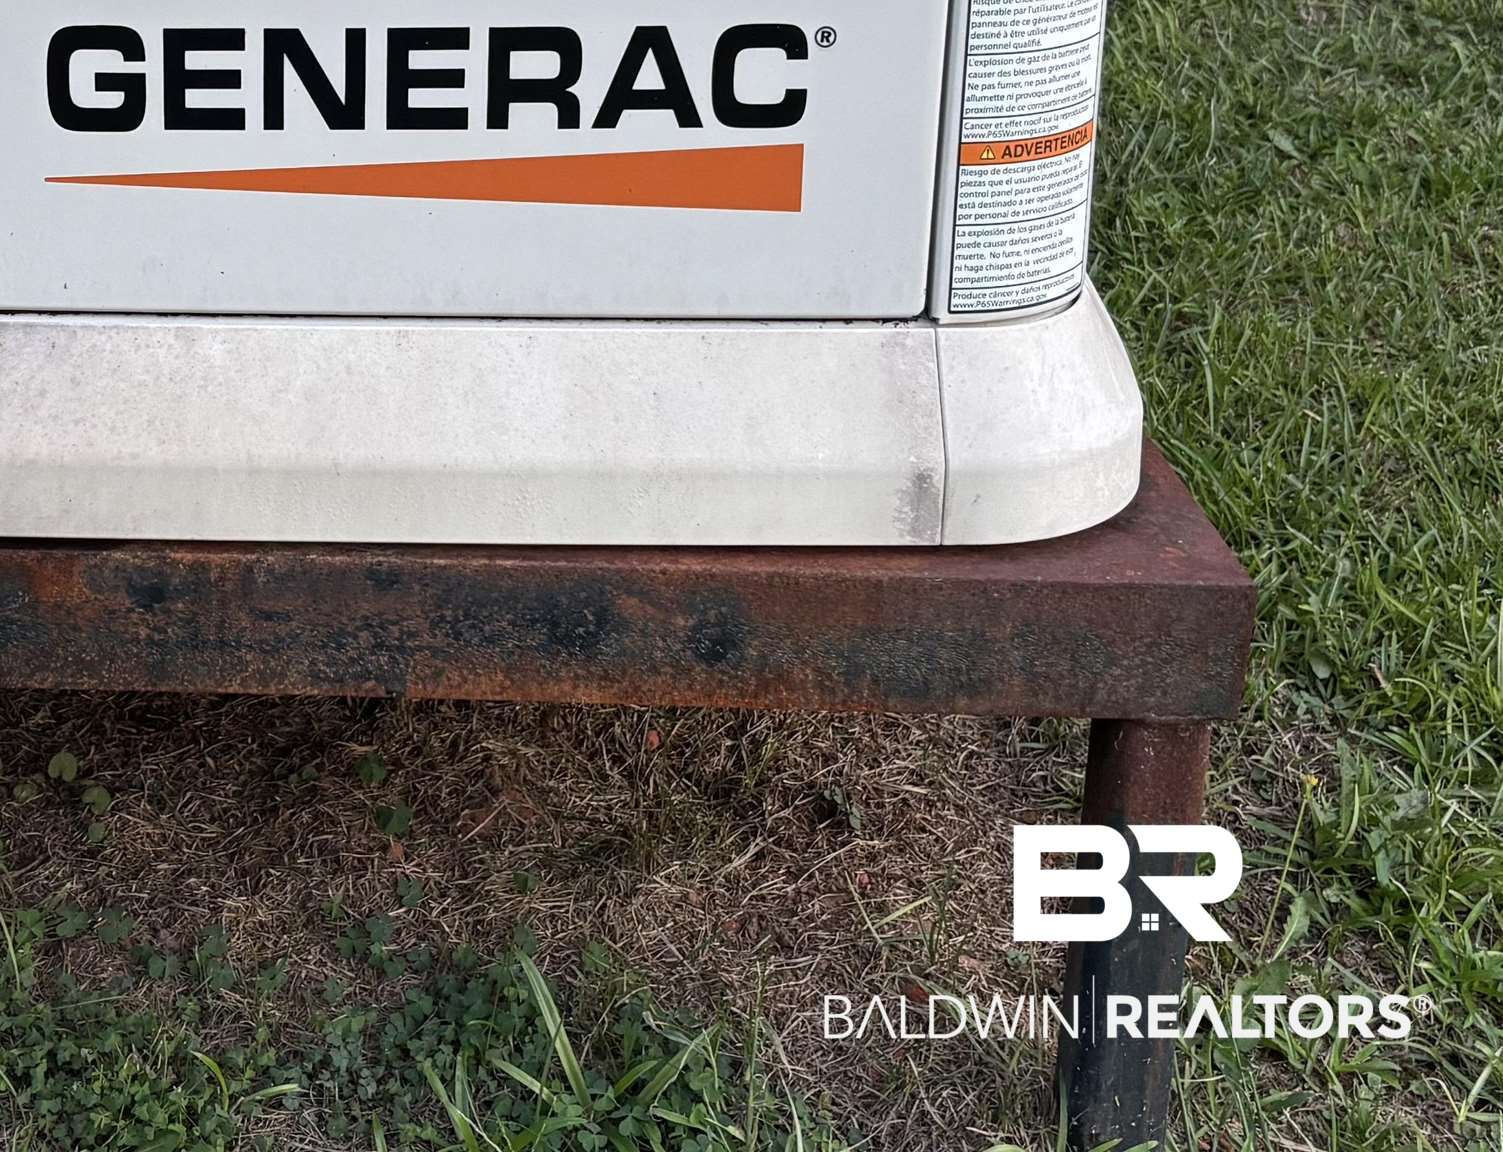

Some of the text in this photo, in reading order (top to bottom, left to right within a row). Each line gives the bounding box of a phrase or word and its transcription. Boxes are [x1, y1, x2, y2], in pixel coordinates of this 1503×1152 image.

[972, 8, 1027, 17] réparable par
[971, 21, 1008, 29] panneau
[970, 30, 1001, 40] destiné
[1010, 28, 1025, 37] être
[970, 42, 1011, 51] personnel
[968, 58, 1014, 68] L'explosion
[1016, 56, 1025, 64] de
[1027, 56, 1040, 64] gaz
[1014, 66, 1046, 76] blessures
[981, 82, 996, 91] pas
[1036, 79, 1047, 88] pas
[966, 93, 1005, 102] allumette
[1006, 92, 1014, 100] ni
[1016, 88, 1052, 100] provoquer
[965, 105, 1004, 114] proximité
[964, 121, 993, 130] Cancer
[994, 120, 1002, 128] et
[1004, 119, 1022, 127] effet
[1024, 117, 1042, 126] nocif
[1001, 128, 1088, 159] ADVERTENCIA
[960, 165, 1036, 177] Riesgo de descarga
[960, 180, 986, 188] piezas
[988, 179, 1004, 188] que
[1005, 177, 1012, 185] el
[1014, 176, 1040, 184] usuario
[959, 190, 989, 198] control
[991, 188, 1012, 198] panel
[1014, 187, 1031, 196] para
[958, 200, 976, 209] está
[978, 198, 1016, 208] destinado
[958, 212, 973, 220] por
[974, 209, 1009, 220] personal
[968, 228, 1005, 239] explosión
[1017, 225, 1027, 234] los
[1028, 222, 1046, 233] gases
[956, 241, 981, 250] puede
[983, 240, 1007, 248] causar
[1009, 237, 1030, 246] daños
[955, 252, 986, 260] muerte.
[990, 251, 1000, 259] No
[954, 264, 962, 272] ni
[964, 264, 983, 273] haga
[985, 261, 1012, 271] chispas
[954, 274, 1016, 284] compartimiento
[952, 290, 987, 300] Produce
